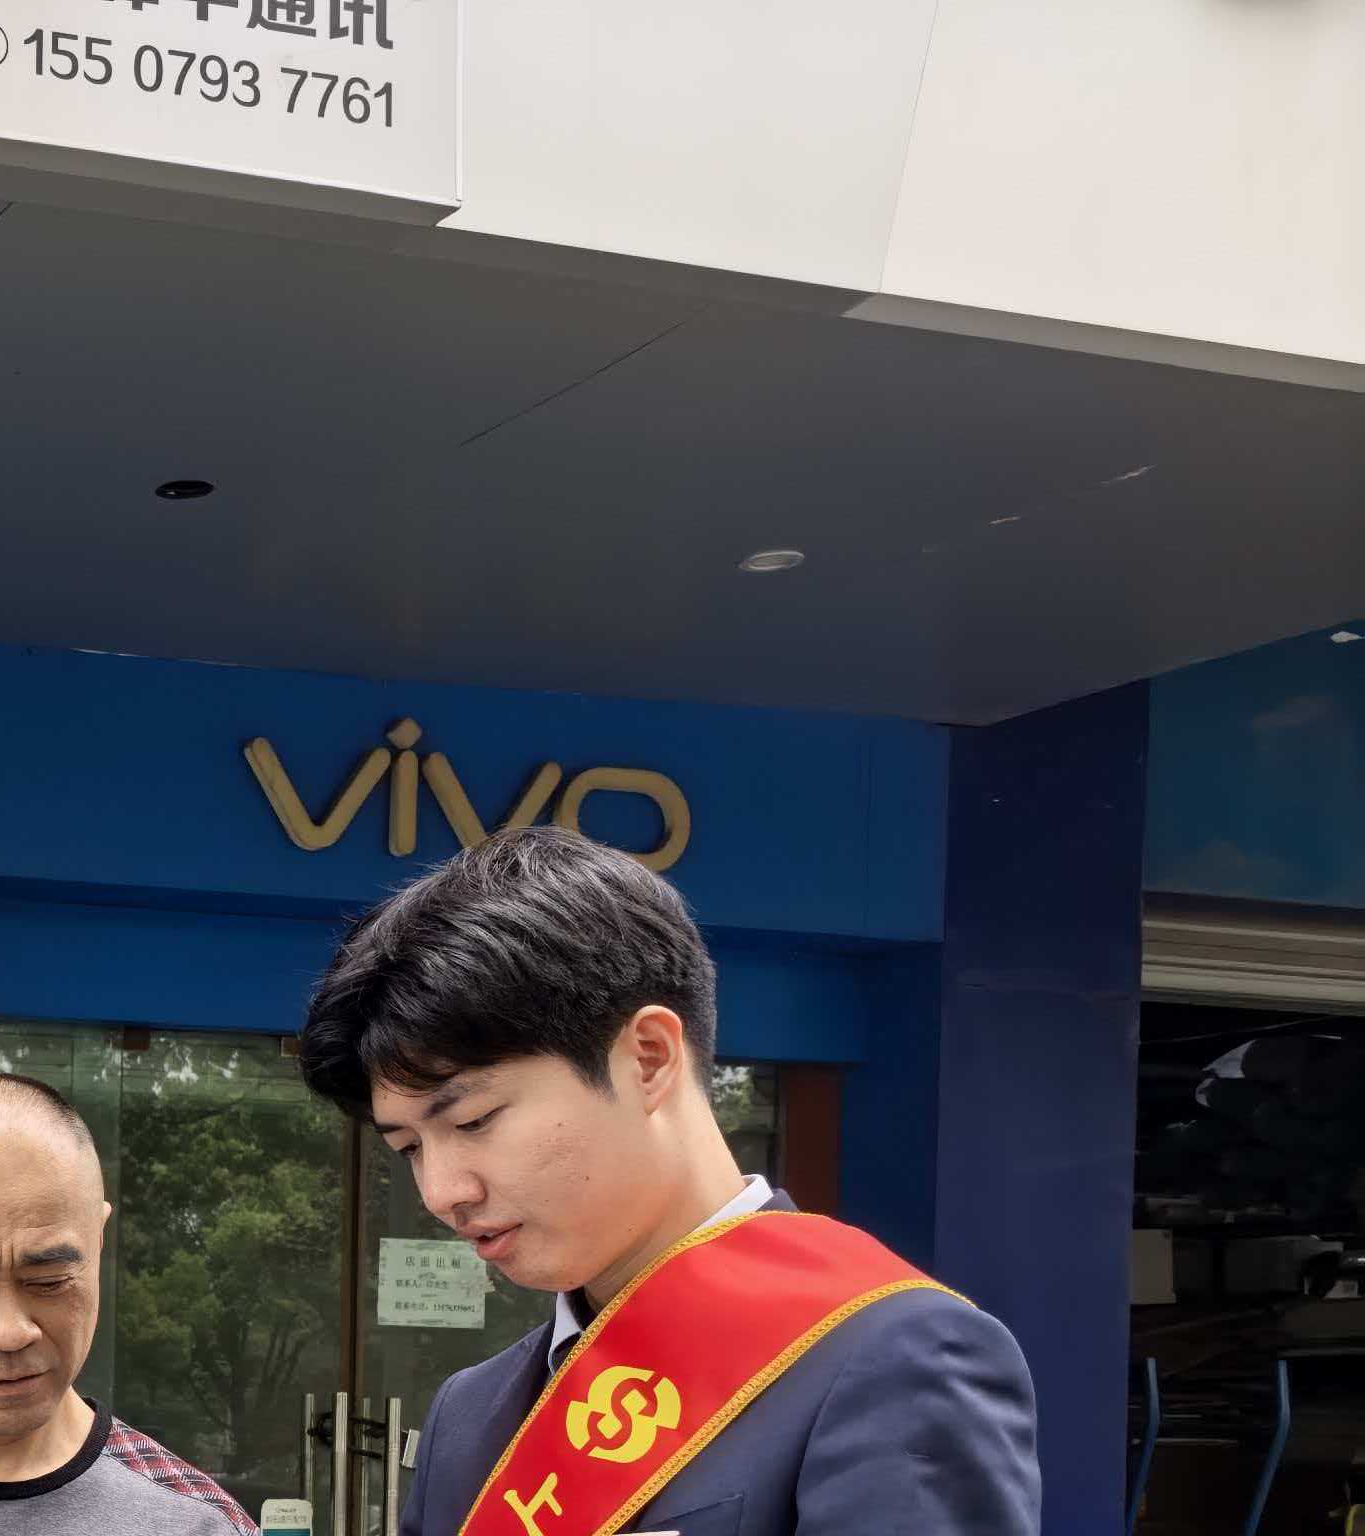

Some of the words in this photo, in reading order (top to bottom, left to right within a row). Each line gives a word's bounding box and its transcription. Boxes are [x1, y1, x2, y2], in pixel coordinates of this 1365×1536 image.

[22, 27, 114, 85] 155
[133, 44, 262, 108] 0793
[279, 67, 394, 128] 7761
[244, 717, 691, 873] vivo
